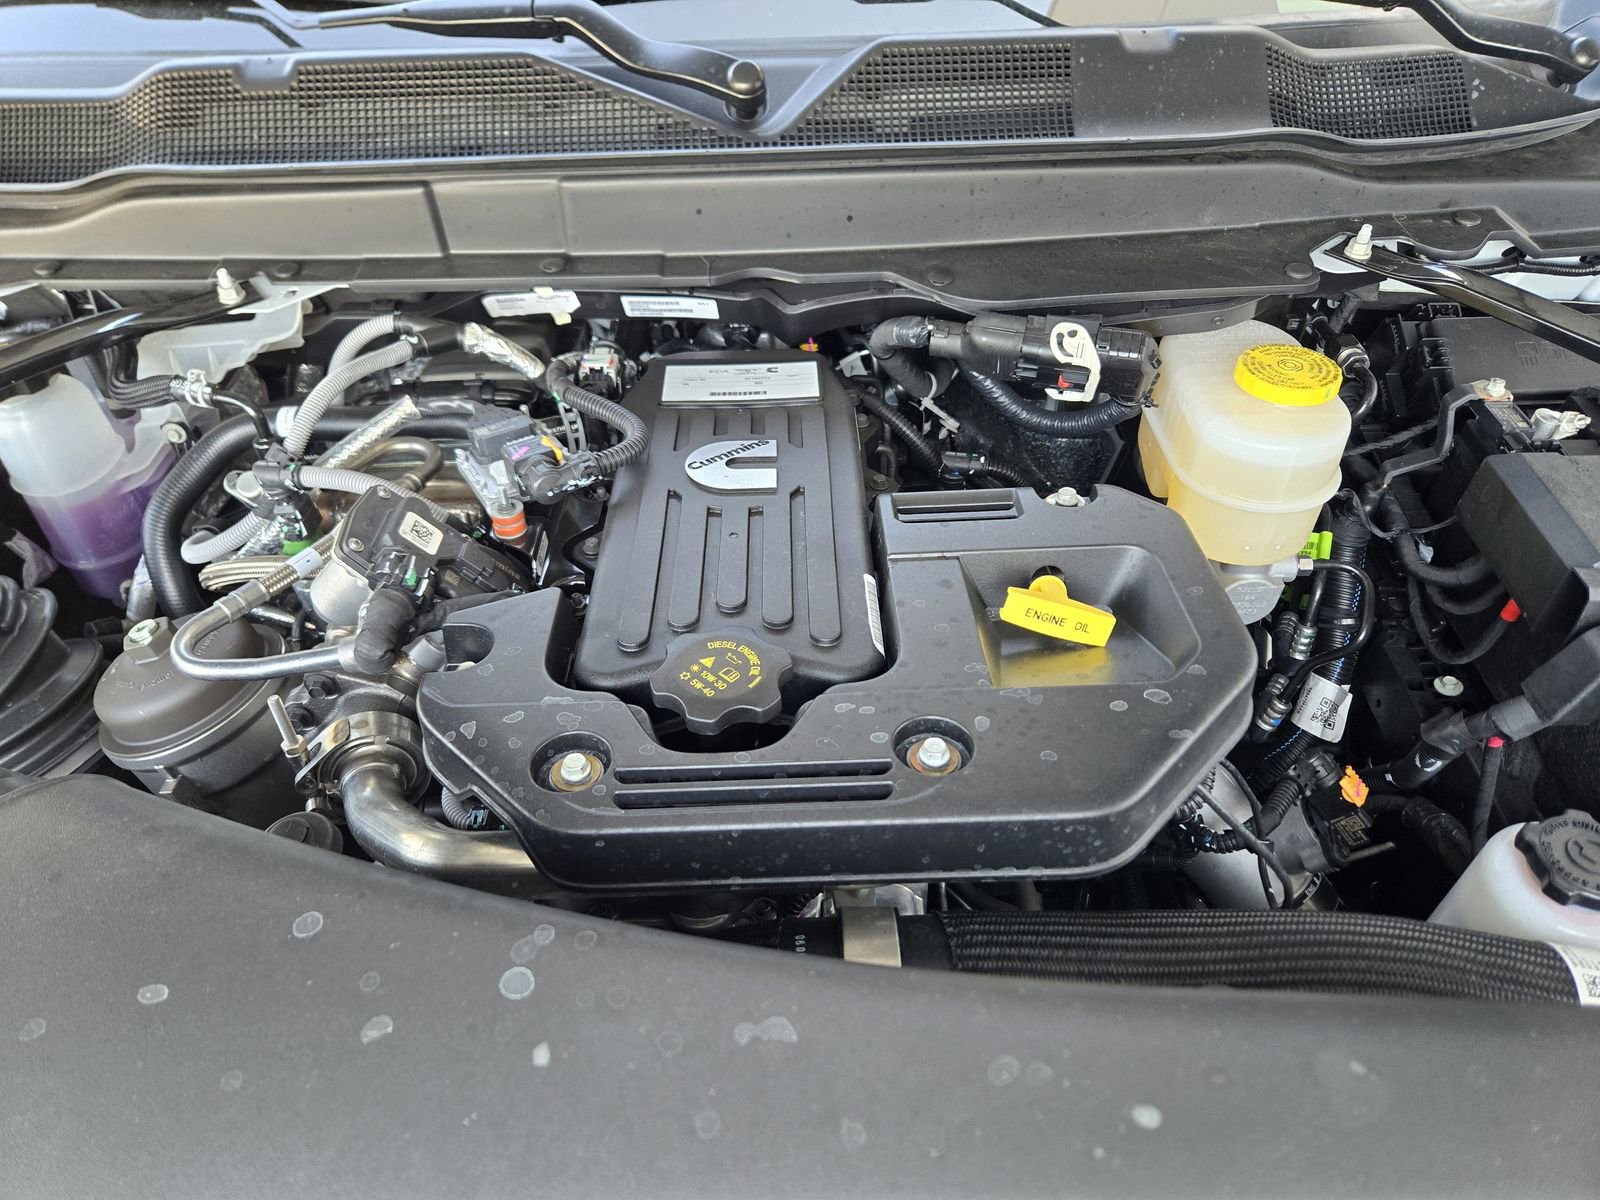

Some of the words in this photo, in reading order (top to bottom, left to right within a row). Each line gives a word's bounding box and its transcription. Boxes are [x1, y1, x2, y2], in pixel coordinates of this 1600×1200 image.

[687, 440, 770, 470] Cummins
[1025, 607, 1068, 627] ENGINE
[1074, 621, 1090, 634] OIL
[707, 640, 738, 650] DIESEL
[737, 645, 761, 667] ENGINE
[690, 678, 716, 697] 5W-40
[700, 670, 728, 690] 10W-30
